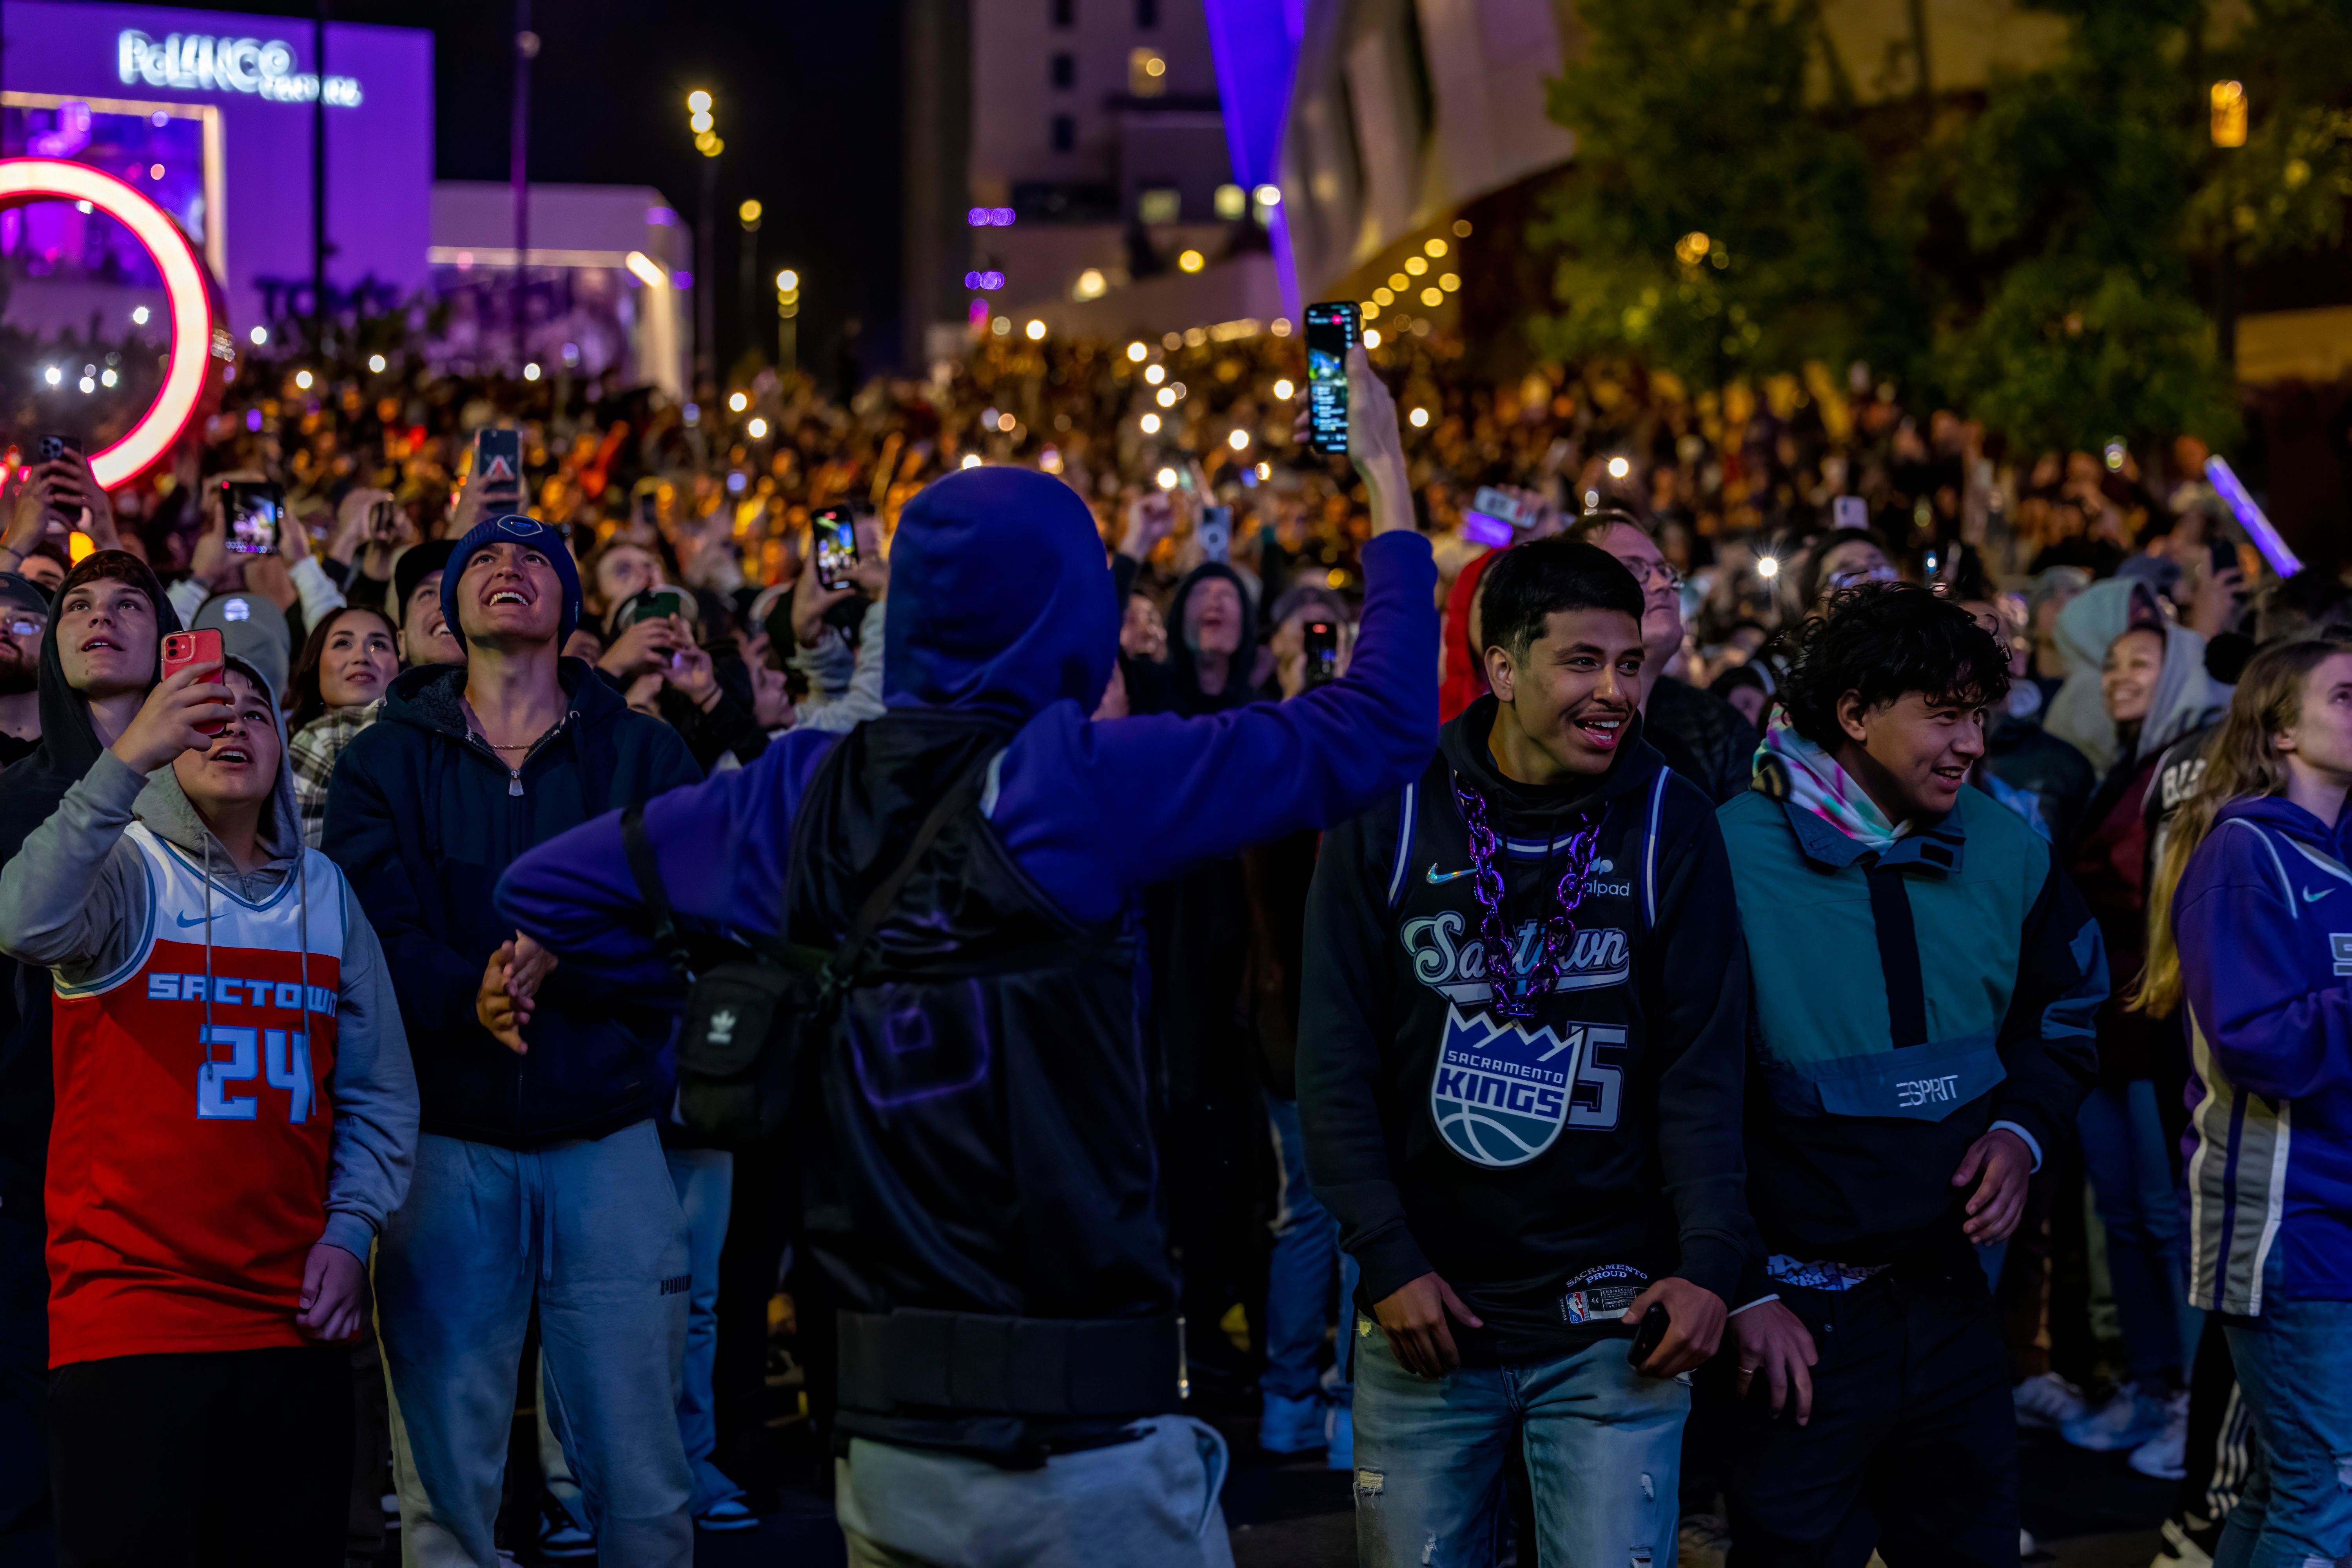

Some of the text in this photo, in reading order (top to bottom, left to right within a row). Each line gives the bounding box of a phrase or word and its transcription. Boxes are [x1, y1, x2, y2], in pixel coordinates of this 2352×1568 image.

[1586, 880, 1630, 897] alpad
[197, 1024, 310, 1124] 24
[1447, 1050, 1564, 1084] SACRAMENTO
[1436, 1069, 1564, 1120] KINGS
[1896, 1074, 1958, 1107] ESPRIT
[1566, 1263, 1648, 1288] SACRAMENTO
[1586, 1270, 1627, 1285] PROUD
